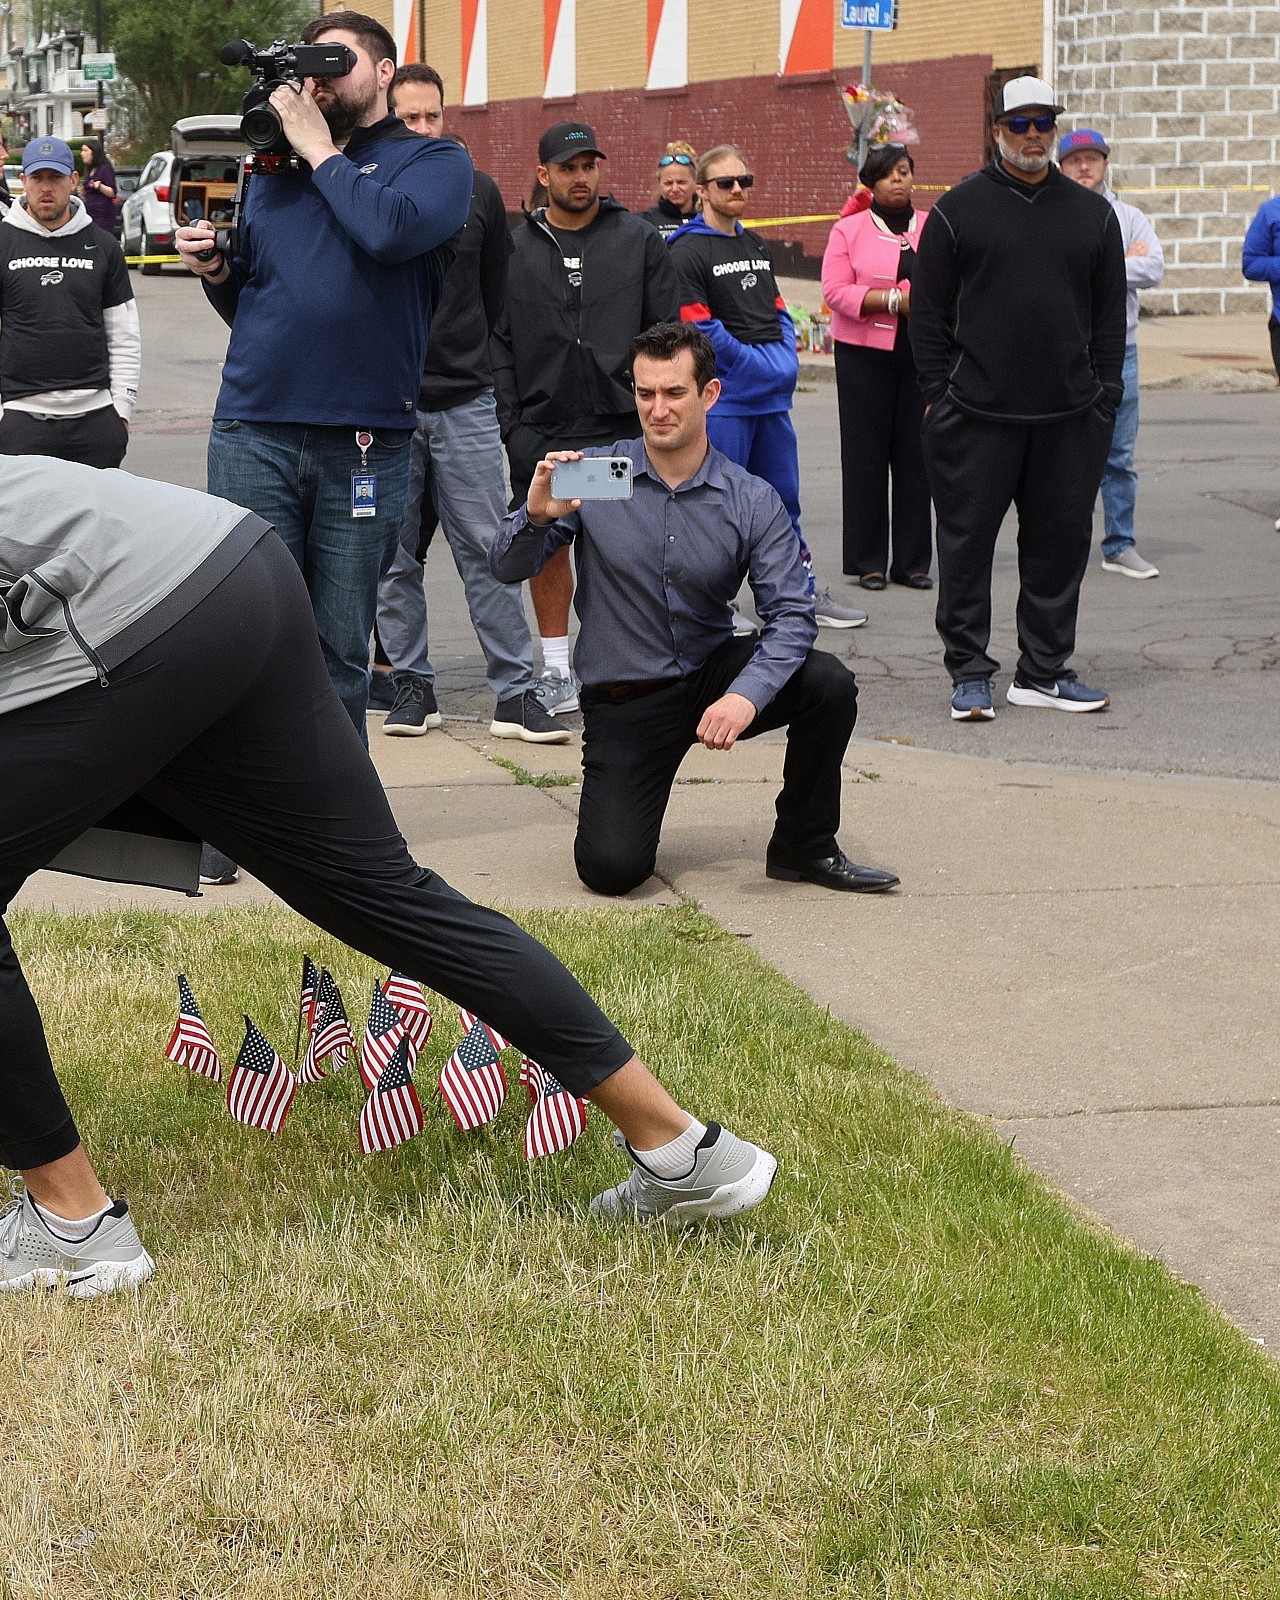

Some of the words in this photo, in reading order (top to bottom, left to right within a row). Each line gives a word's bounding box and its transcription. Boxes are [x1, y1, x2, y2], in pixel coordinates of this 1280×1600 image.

[843, 1, 880, 24] Laurel
[8, 257, 60, 270] CHOOSE
[61, 257, 94, 270] LOVE
[712, 260, 751, 277] CHOOSE
